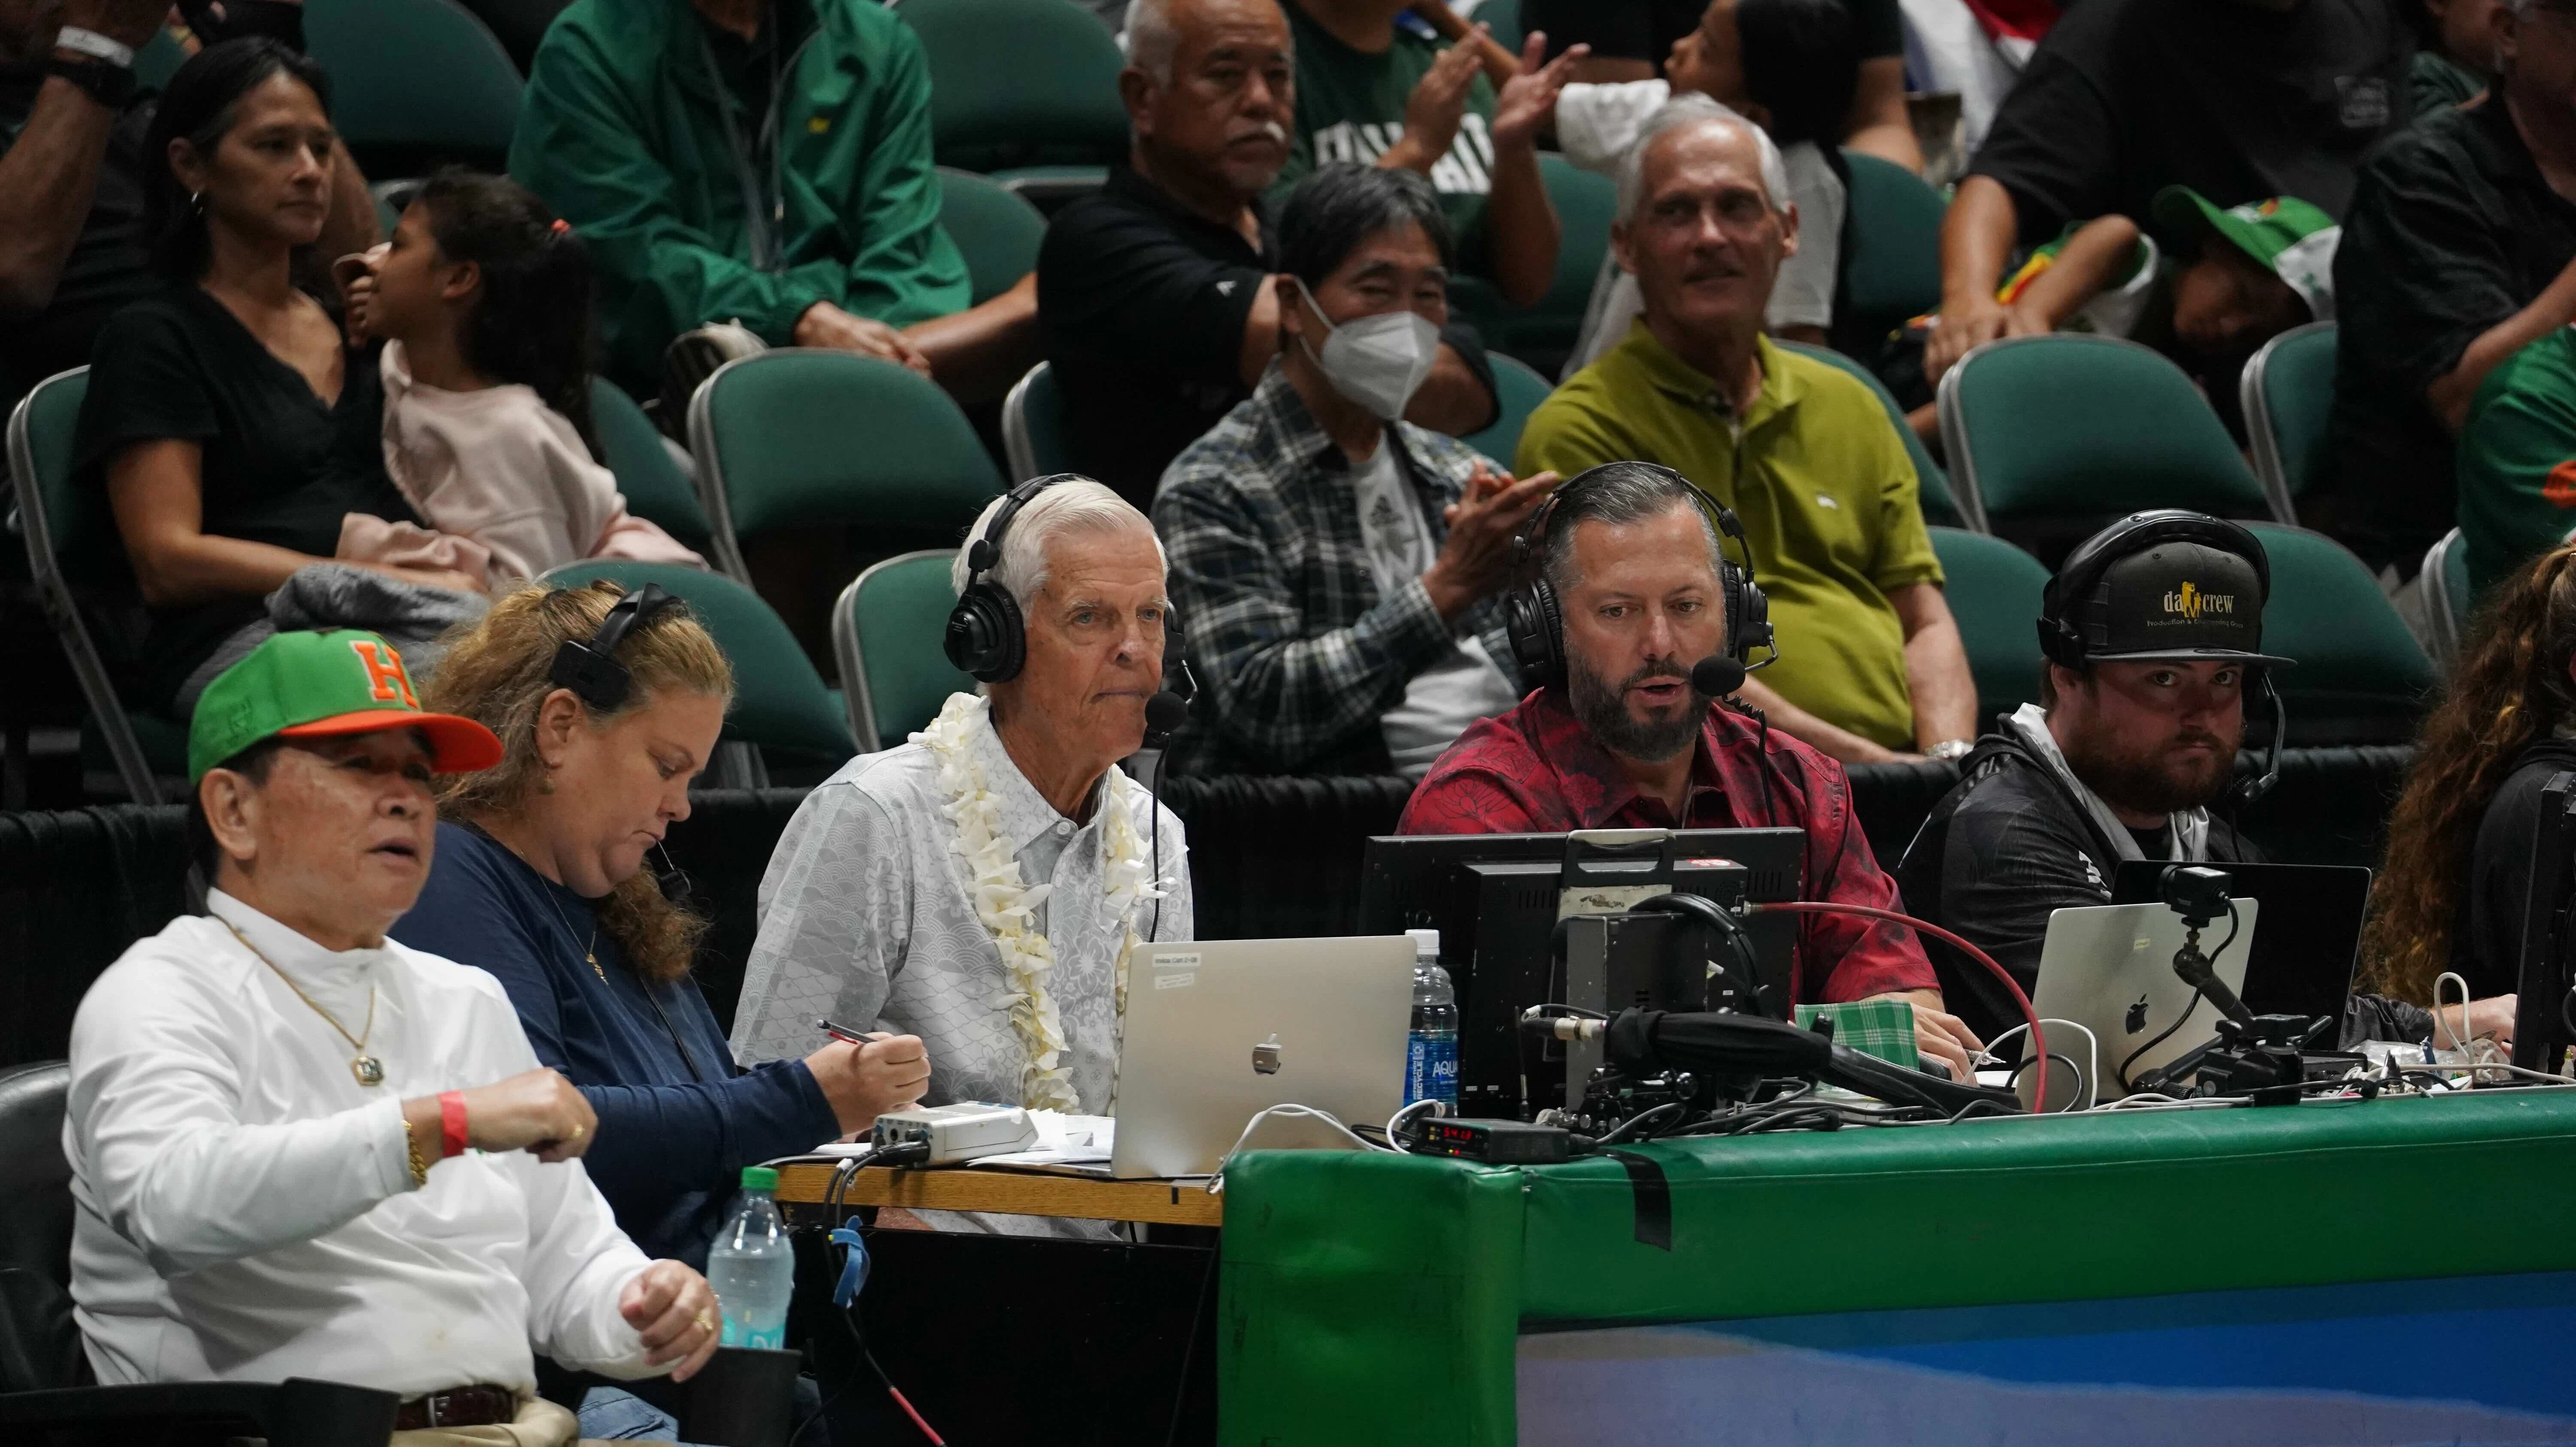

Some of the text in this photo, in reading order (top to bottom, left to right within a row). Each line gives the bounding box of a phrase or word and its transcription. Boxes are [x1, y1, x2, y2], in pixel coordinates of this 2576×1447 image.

[2164, 591, 2234, 613] da crew
[349, 640, 419, 710] H
